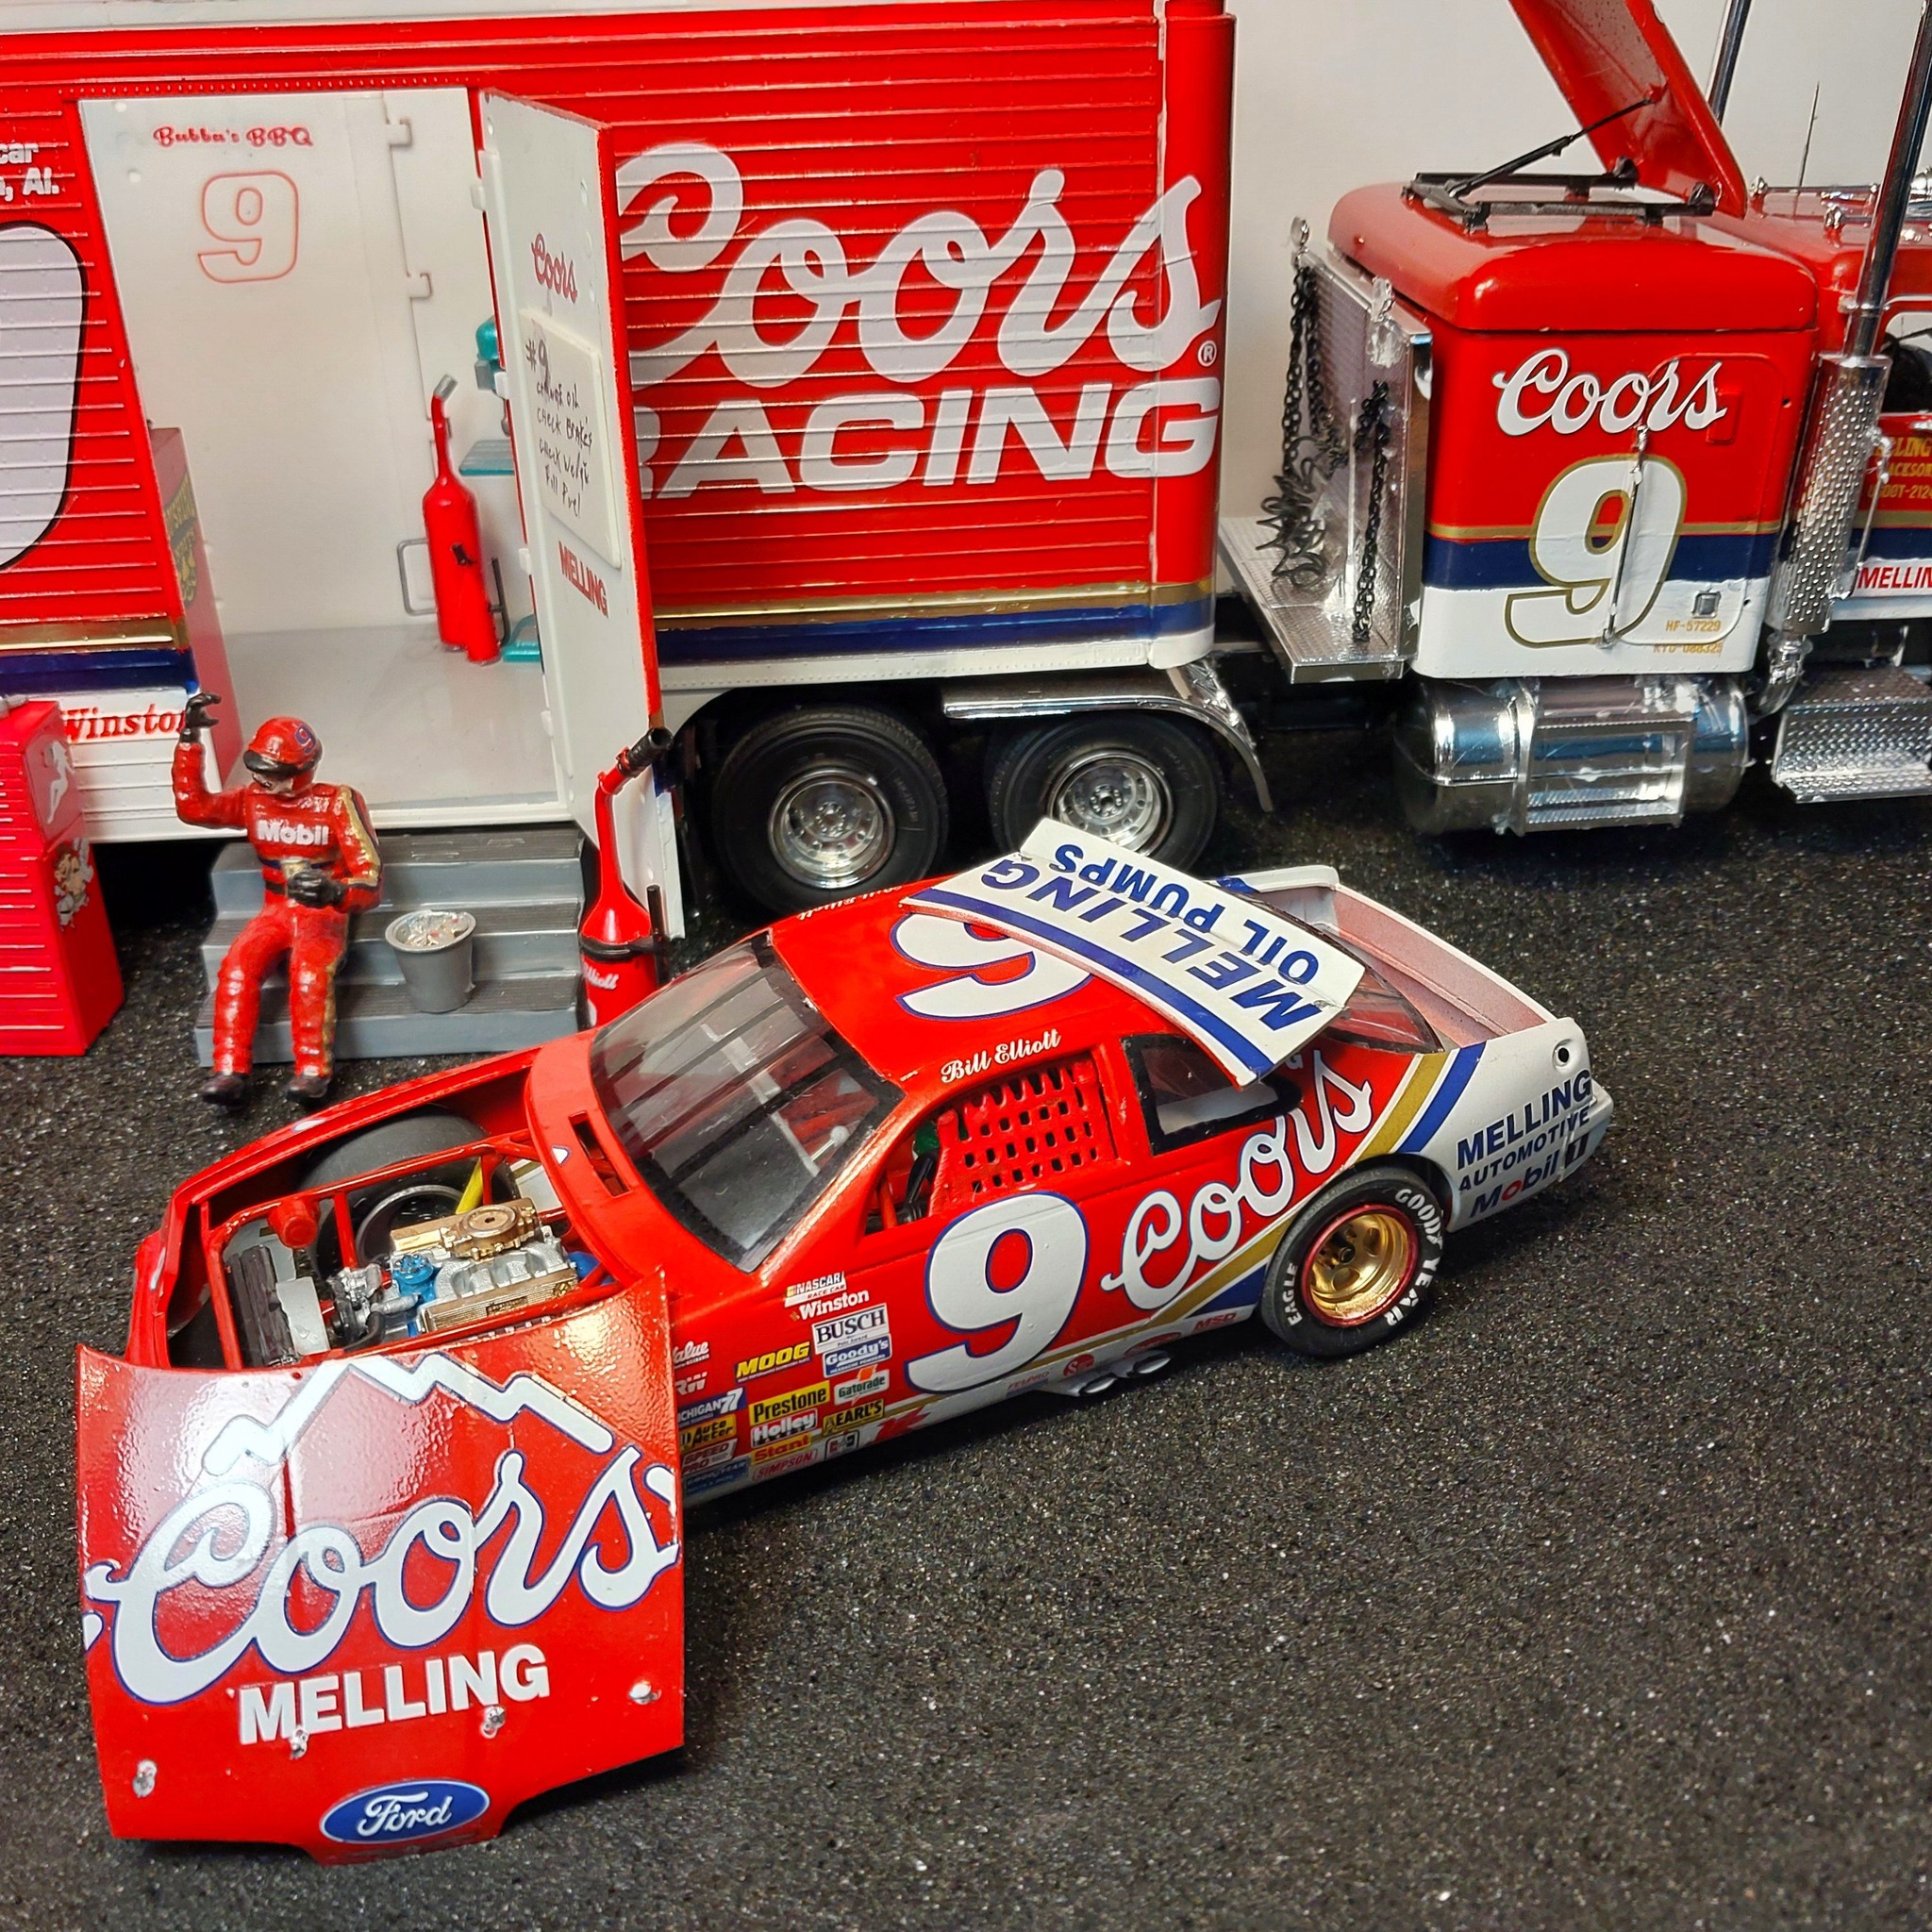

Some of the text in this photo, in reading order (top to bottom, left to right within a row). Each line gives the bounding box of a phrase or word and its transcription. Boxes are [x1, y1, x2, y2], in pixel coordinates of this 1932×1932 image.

[153, 126, 314, 148] Bubba's BBQ
[197, 170, 299, 284] 9
[530, 232, 578, 304] Coors
[1491, 347, 1728, 437] Coors
[558, 540, 609, 619] MELLING
[1504, 453, 1688, 649] 9
[257, 819, 329, 846] Mobil
[979, 858, 1324, 1032] MELLING
[1048, 843, 1321, 986] OIL PUMPS
[941, 1028, 1062, 1083] Bill Elliott
[1456, 1069, 1592, 1171] MELLING
[1458, 1105, 1591, 1192] AUTOMOTIVE
[1100, 1047, 1374, 1311] Coors
[1469, 1148, 1561, 1219] Mobil
[795, 1272, 842, 1295] NASCAR
[798, 1290, 870, 1321] Winston
[903, 1190, 1090, 1395] 9
[1281, 1262, 1304, 1326] EAGLE
[815, 1308, 887, 1344] BUSCH
[825, 1339, 889, 1366] Goody's
[736, 1341, 810, 1378] MOOG
[838, 1375, 886, 1398] Gatorade
[677, 1399, 722, 1422] ICHIGAN
[753, 1388, 827, 1424] Prestone
[754, 1412, 816, 1441] Holley
[836, 1400, 882, 1426] EARL'S
[84, 1446, 681, 1706] Coors
[238, 1643, 551, 1745] MELLING
[355, 1790, 454, 1839] Ford
